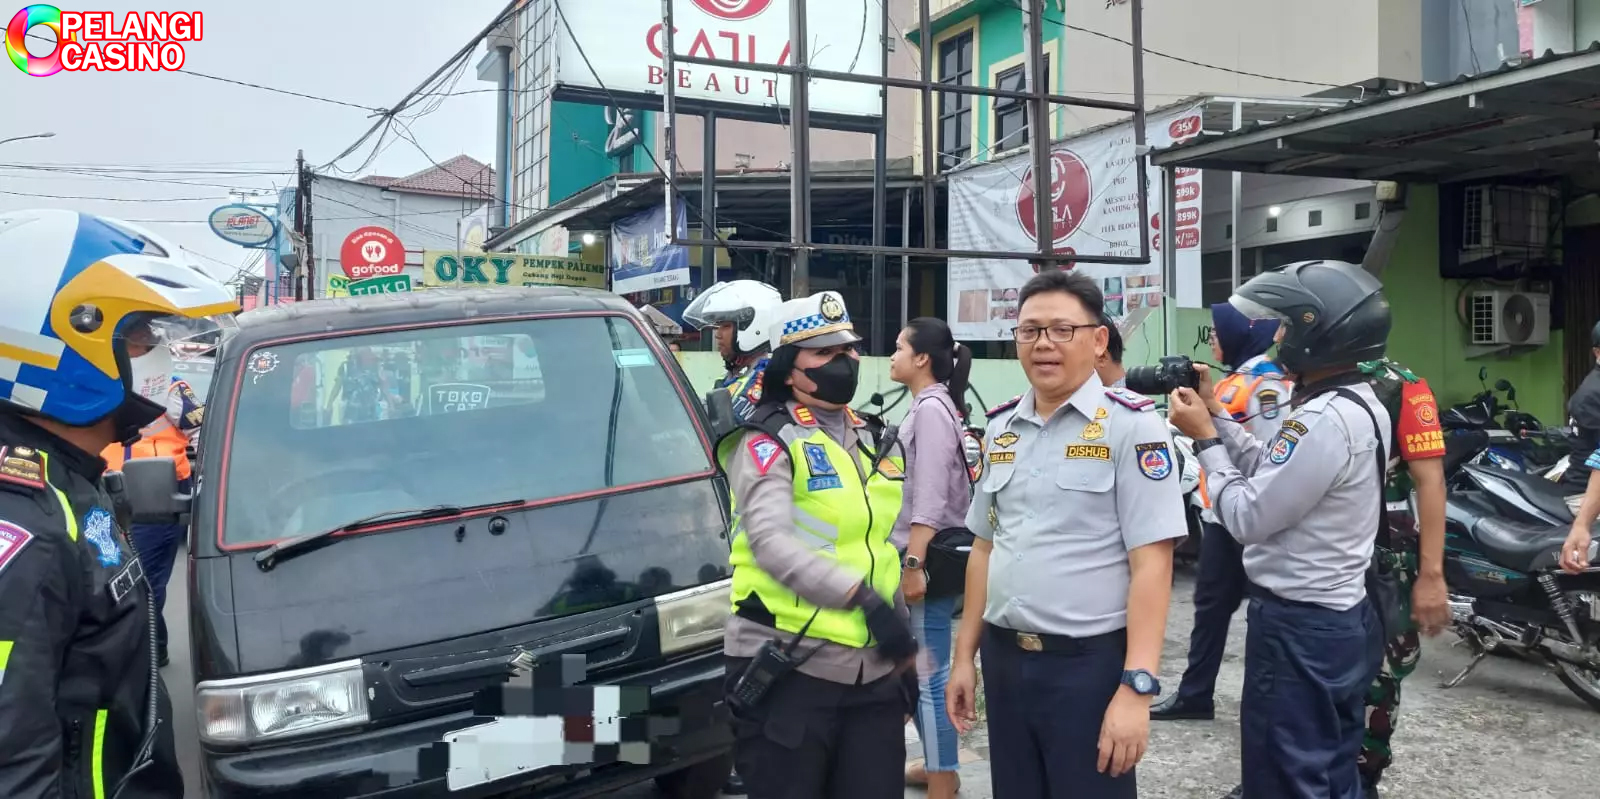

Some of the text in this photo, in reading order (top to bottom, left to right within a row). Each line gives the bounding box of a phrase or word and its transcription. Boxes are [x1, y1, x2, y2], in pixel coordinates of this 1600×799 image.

[648, 66, 777, 97] BEAUT
[434, 255, 516, 284] OKY
[523, 258, 565, 269] PEMPEK
[352, 264, 399, 276] gofood
[354, 281, 407, 296] TOKO
[437, 391, 482, 402] TOKO
[1069, 446, 1108, 458] DISHUB
